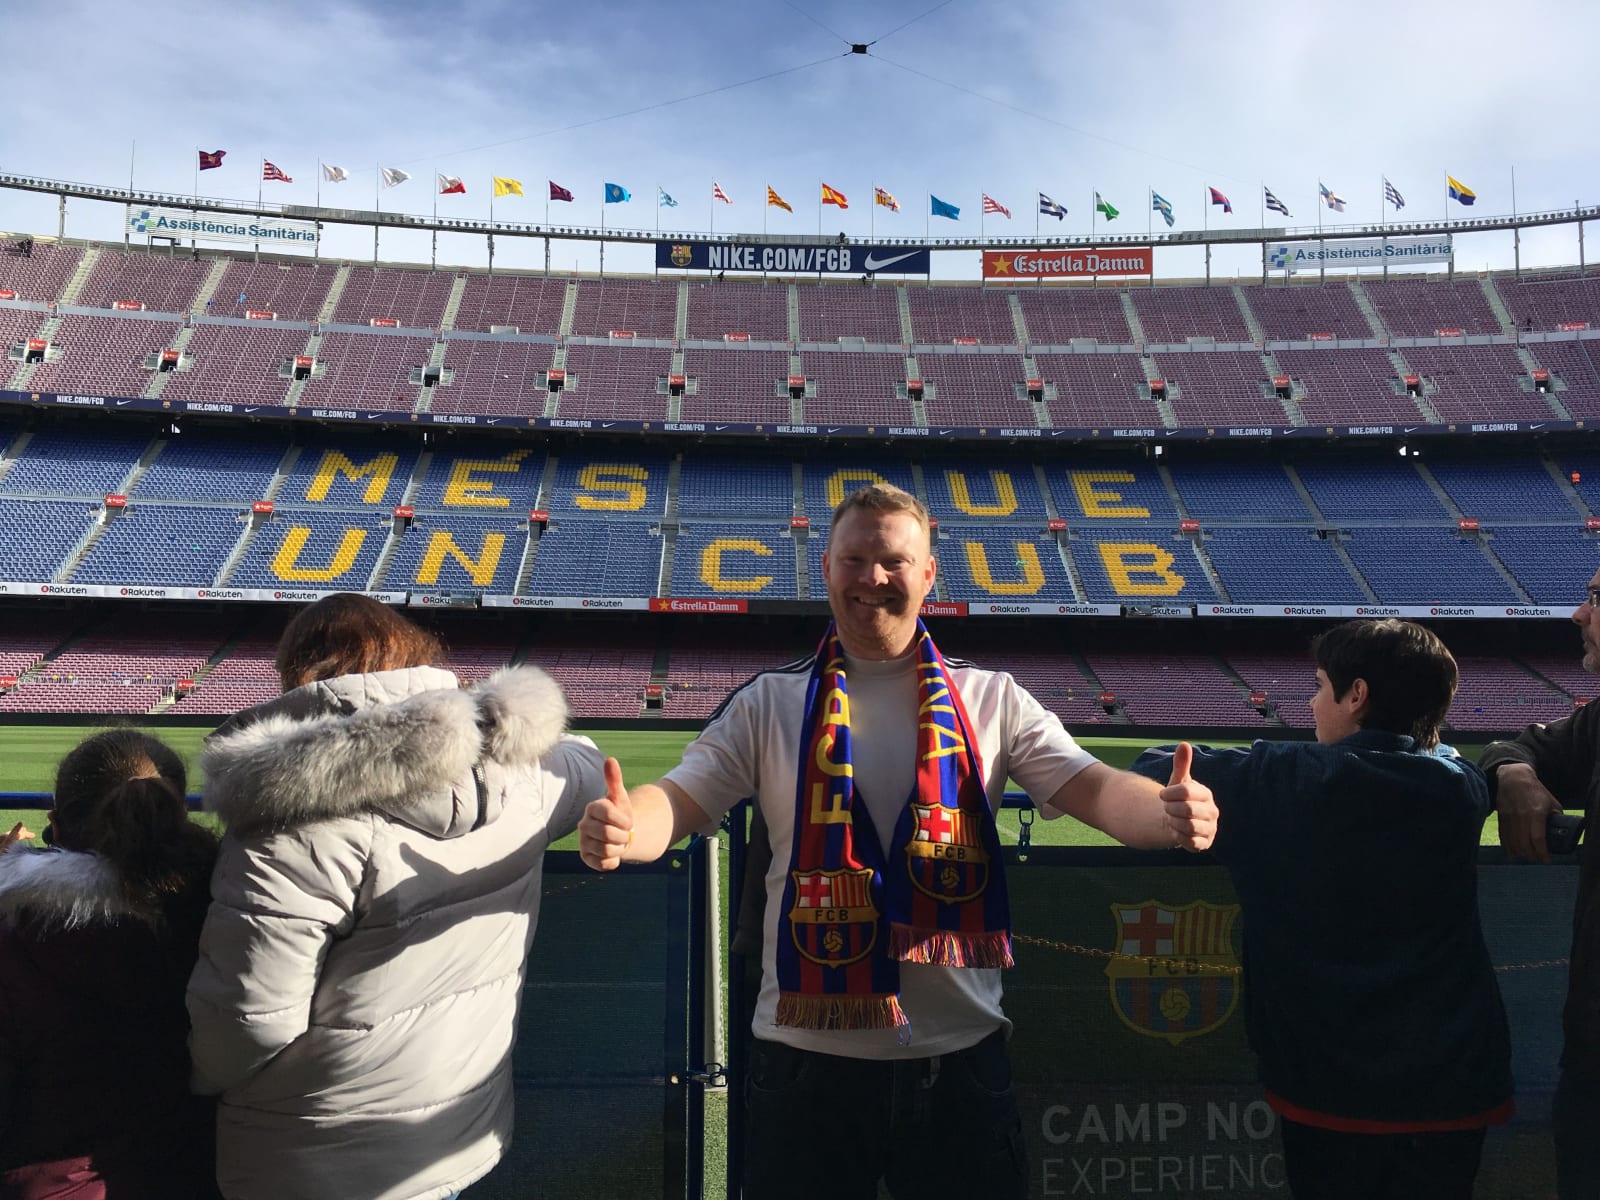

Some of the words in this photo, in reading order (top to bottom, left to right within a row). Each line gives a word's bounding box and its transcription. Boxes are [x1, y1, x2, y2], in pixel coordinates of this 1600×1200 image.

[708, 246, 851, 271] NIKE.COM/FCB
[1013, 254, 1083, 274] Estrella
[1085, 254, 1145, 273] Damm
[56, 394, 105, 405] NIKE.COM/FCB
[186, 402, 233, 413] NIKE.COM/FCB
[312, 409, 356, 419] NIKE.COM/FCB
[433, 414, 476, 424] NIKE.COM/FCB
[550, 418, 592, 428] NIKE.COM/FCB
[664, 422, 705, 431] NIKE.COM/FCB
[776, 425, 818, 434] NIKE.COM/FCB
[1348, 426, 1393, 435] NIKE.COM/FCB
[1471, 423, 1518, 433] NIKE.COM/FCB
[889, 427, 929, 436] NIKE.COM/FCB
[1000, 428, 1041, 437] NIKE.COM/FCB
[1113, 428, 1155, 437] NIKE.COM/FCB
[1229, 427, 1272, 436] NIKE.COM/FCB
[270, 526, 507, 586] UN
[48, 585, 87, 595] Rakuten
[128, 587, 166, 597] Rakuten
[205, 589, 243, 599] Rakuten
[281, 591, 318, 600] Rakuten
[430, 596, 450, 604] Raku
[520, 598, 554, 606] Rakuten
[589, 599, 623, 608] Rakuten
[670, 600, 708, 611] Estrella
[708, 601, 739, 612] Damm
[927, 604, 958, 615] Damm
[997, 605, 1030, 613] Rakuten
[1065, 605, 1099, 614] Rakuten
[1151, 607, 1181, 615] akuten
[1219, 606, 1254, 615] Rakuten
[1291, 606, 1326, 615] Rakuten
[1364, 606, 1400, 615] Rakuten
[1438, 607, 1474, 616] Rakuten
[1514, 607, 1550, 616] Rakuten
[934, 844, 967, 859] FCB
[815, 909, 849, 922] FCB
[1041, 1101, 1187, 1144] CAMP
[1207, 1100, 1276, 1141] NO
[1042, 1153, 1285, 1195] EXPERIENC
